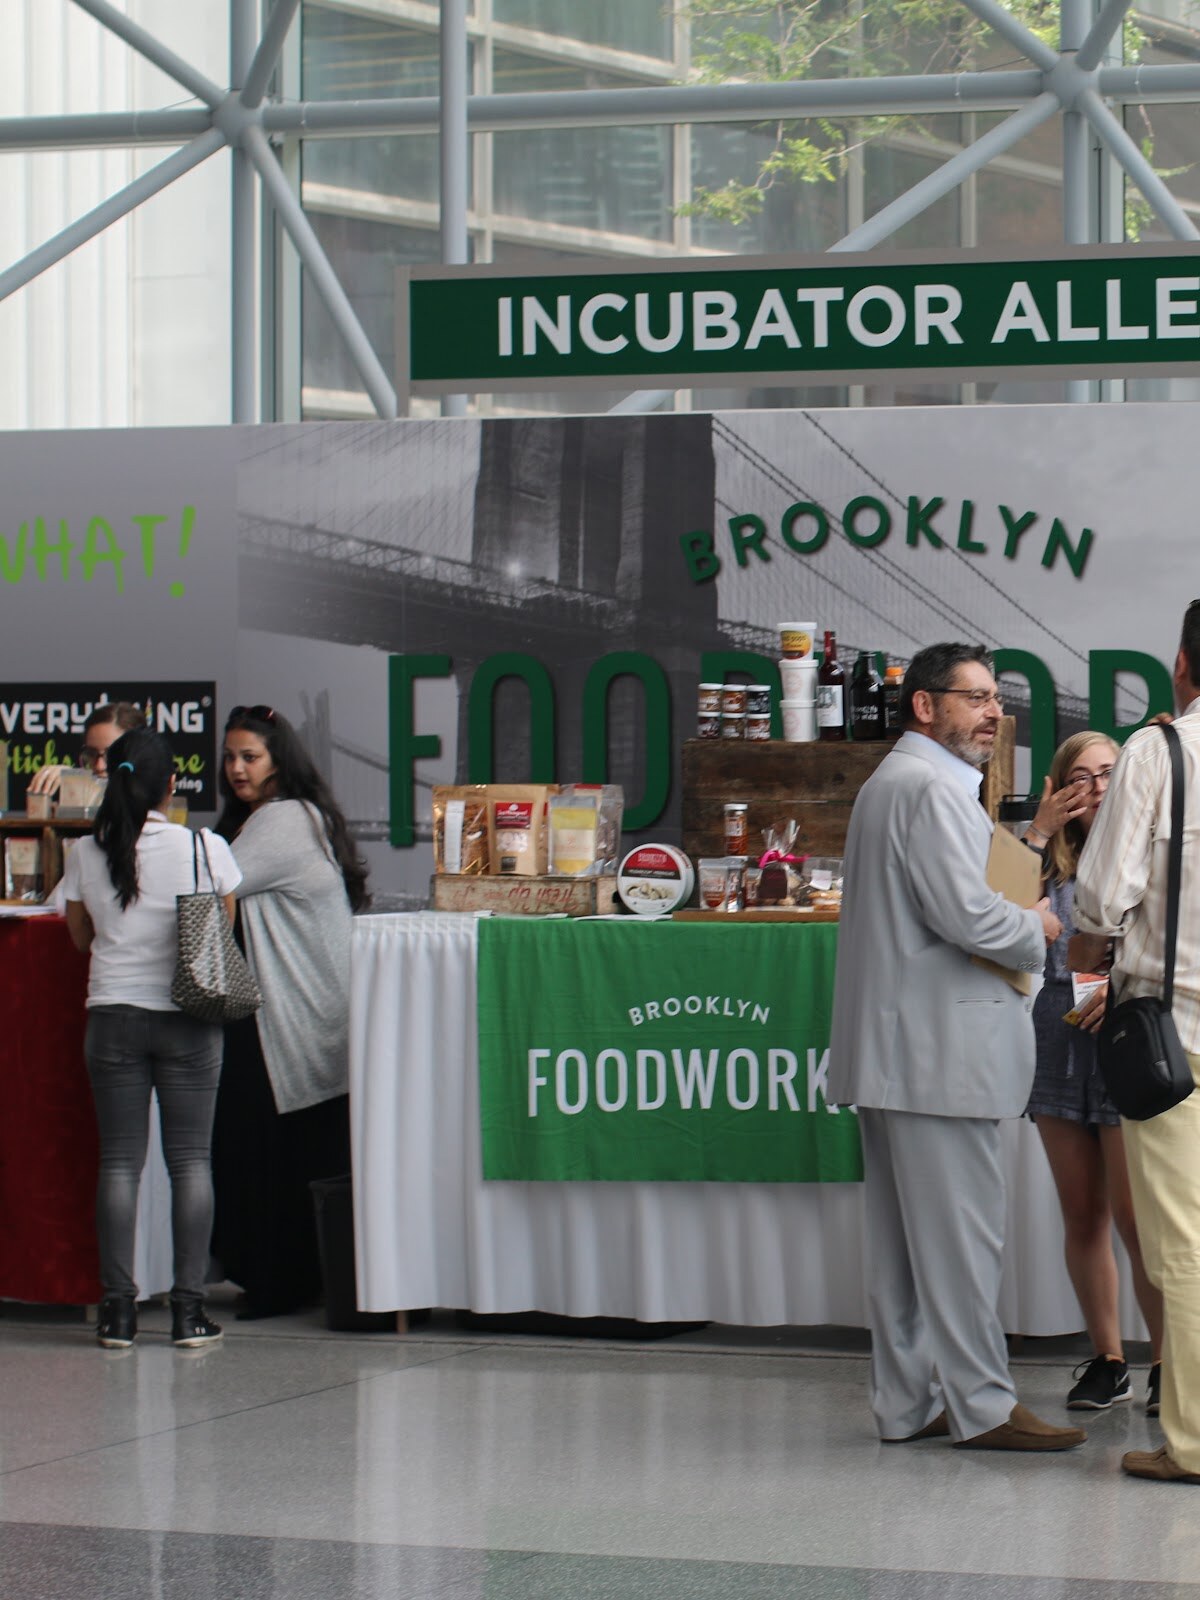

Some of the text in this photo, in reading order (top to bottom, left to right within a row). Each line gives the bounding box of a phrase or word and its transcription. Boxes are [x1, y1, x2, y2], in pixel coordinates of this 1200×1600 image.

[497, 283, 964, 357] INCUBATOR
[679, 495, 1094, 582] BROOKLYN
[628, 995, 770, 1027] BROOKLYN
[528, 1048, 858, 1118] FOODWORK
